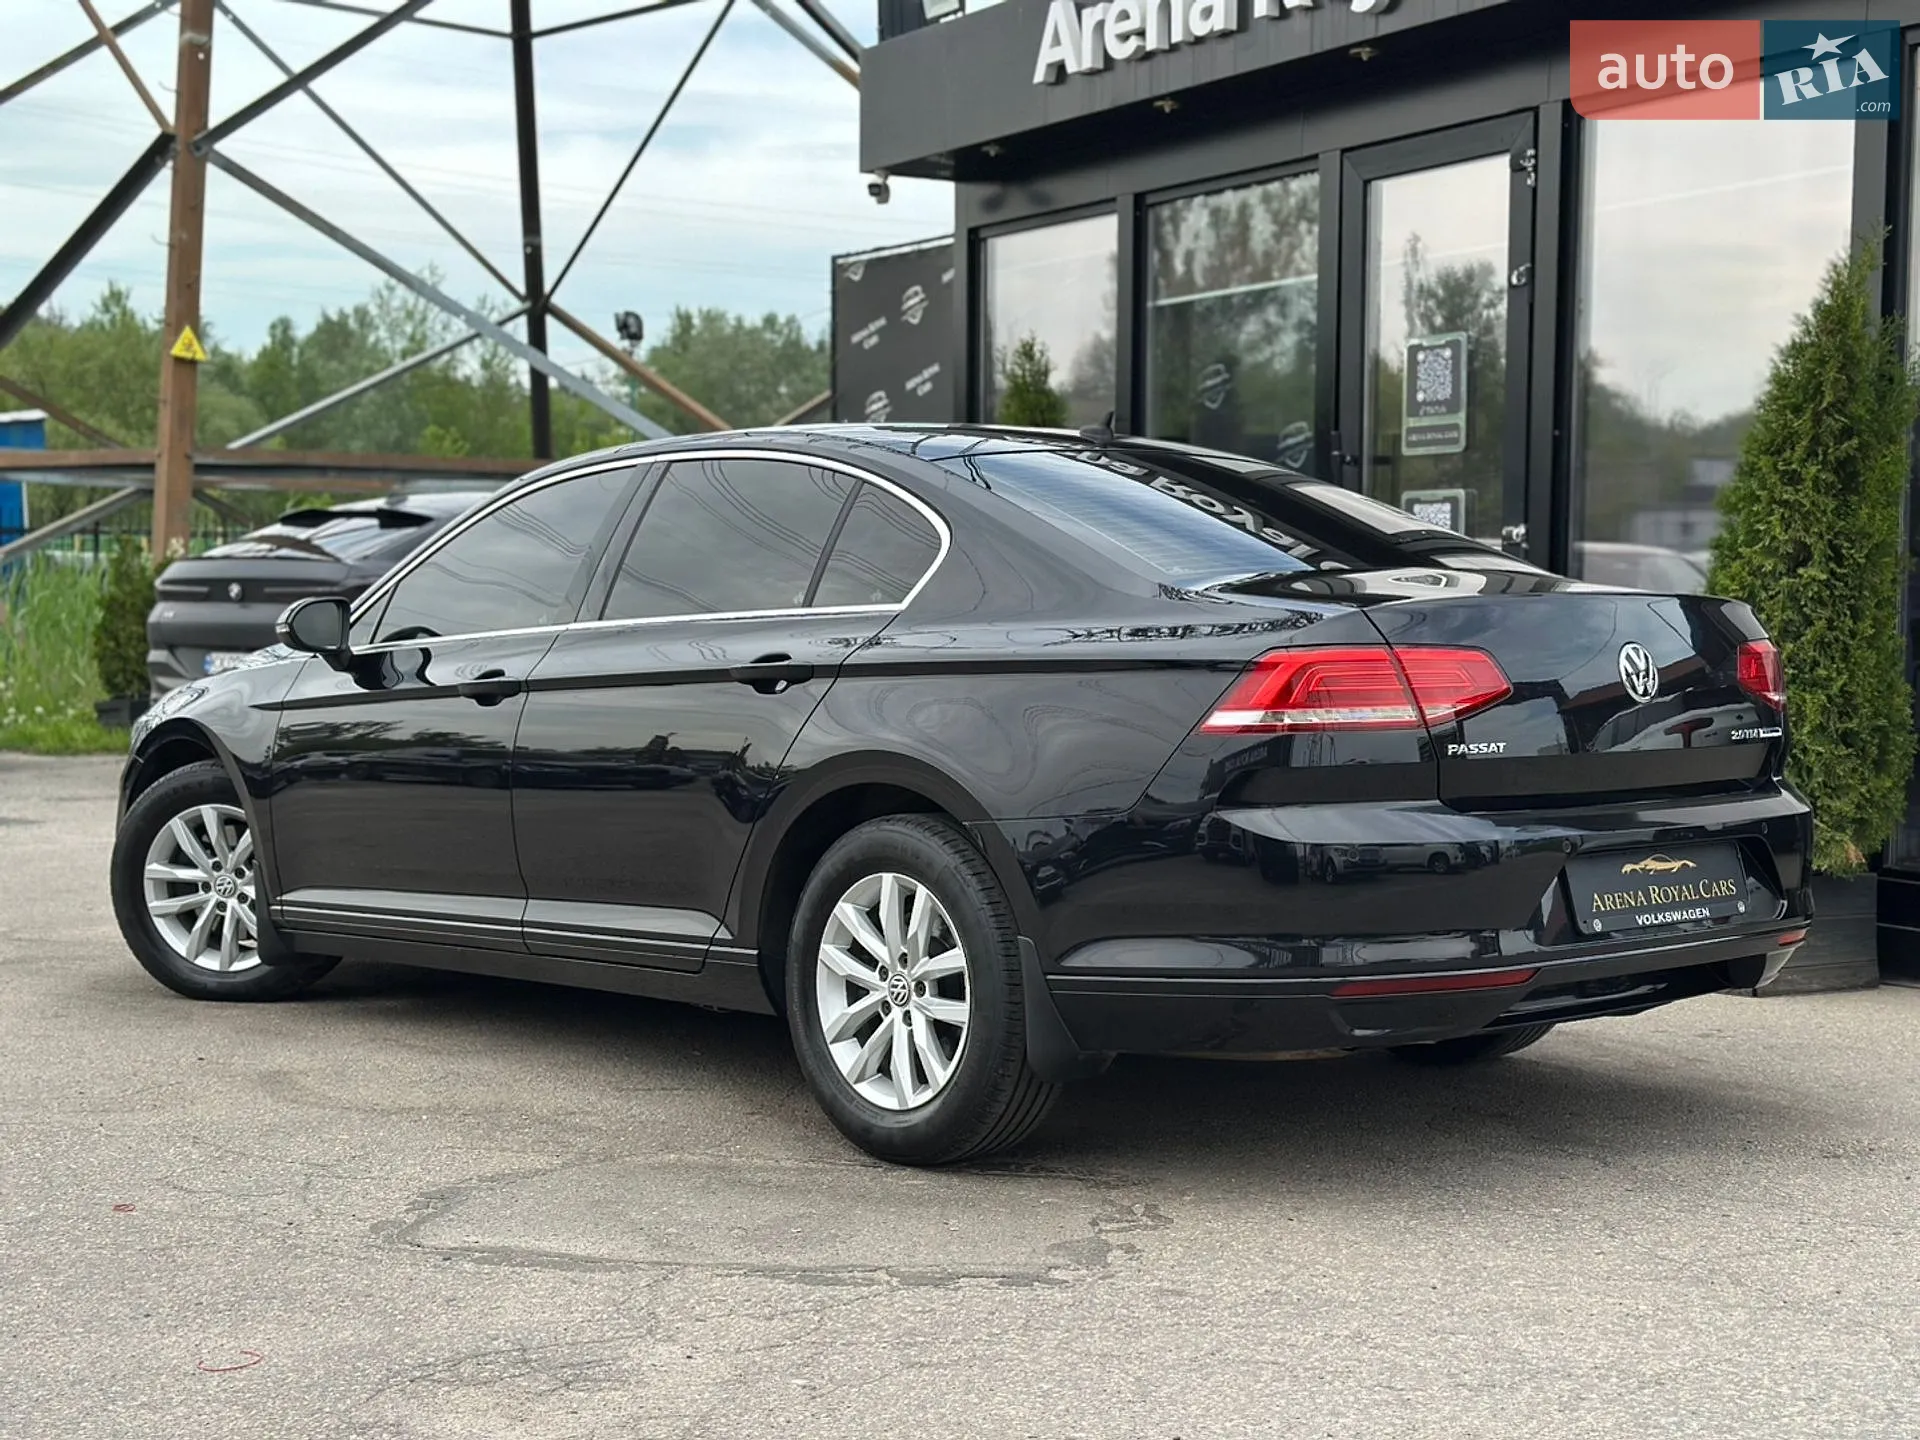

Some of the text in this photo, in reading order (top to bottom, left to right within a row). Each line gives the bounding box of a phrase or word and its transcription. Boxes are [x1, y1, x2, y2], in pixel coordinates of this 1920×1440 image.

[1032, 0, 1238, 84] Arena
[1447, 742, 1507, 756] PASSAT
[1591, 878, 1737, 912] ARENA ROYAL CARS
[1635, 907, 1711, 926] VOLKSWAGEN
